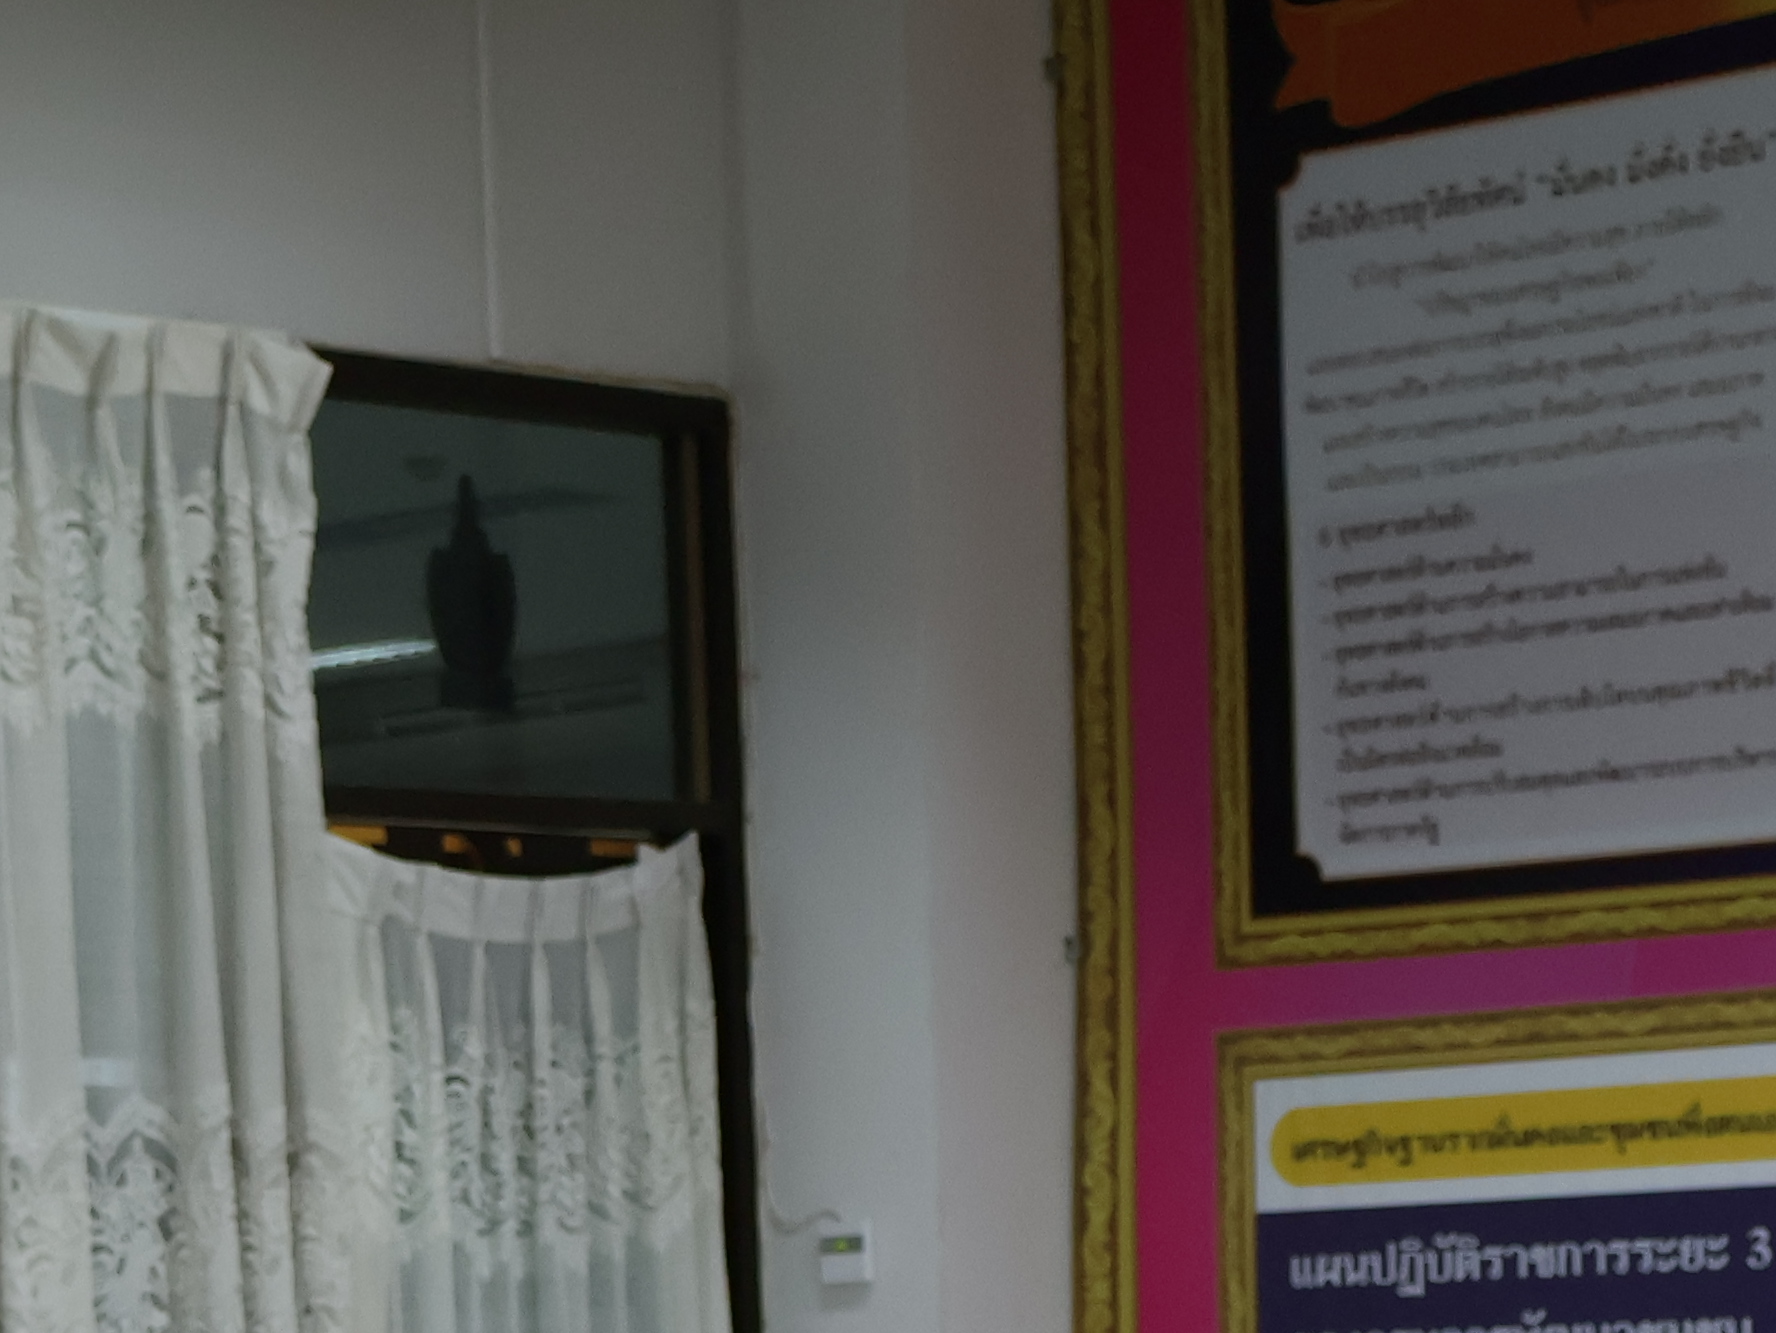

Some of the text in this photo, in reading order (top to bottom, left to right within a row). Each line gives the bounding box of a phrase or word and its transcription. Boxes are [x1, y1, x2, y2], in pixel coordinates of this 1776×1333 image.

[1287, 1231, 1730, 1299] แผนปฏิบัติราชการระยะ
[1744, 1227, 1774, 1271] 3
